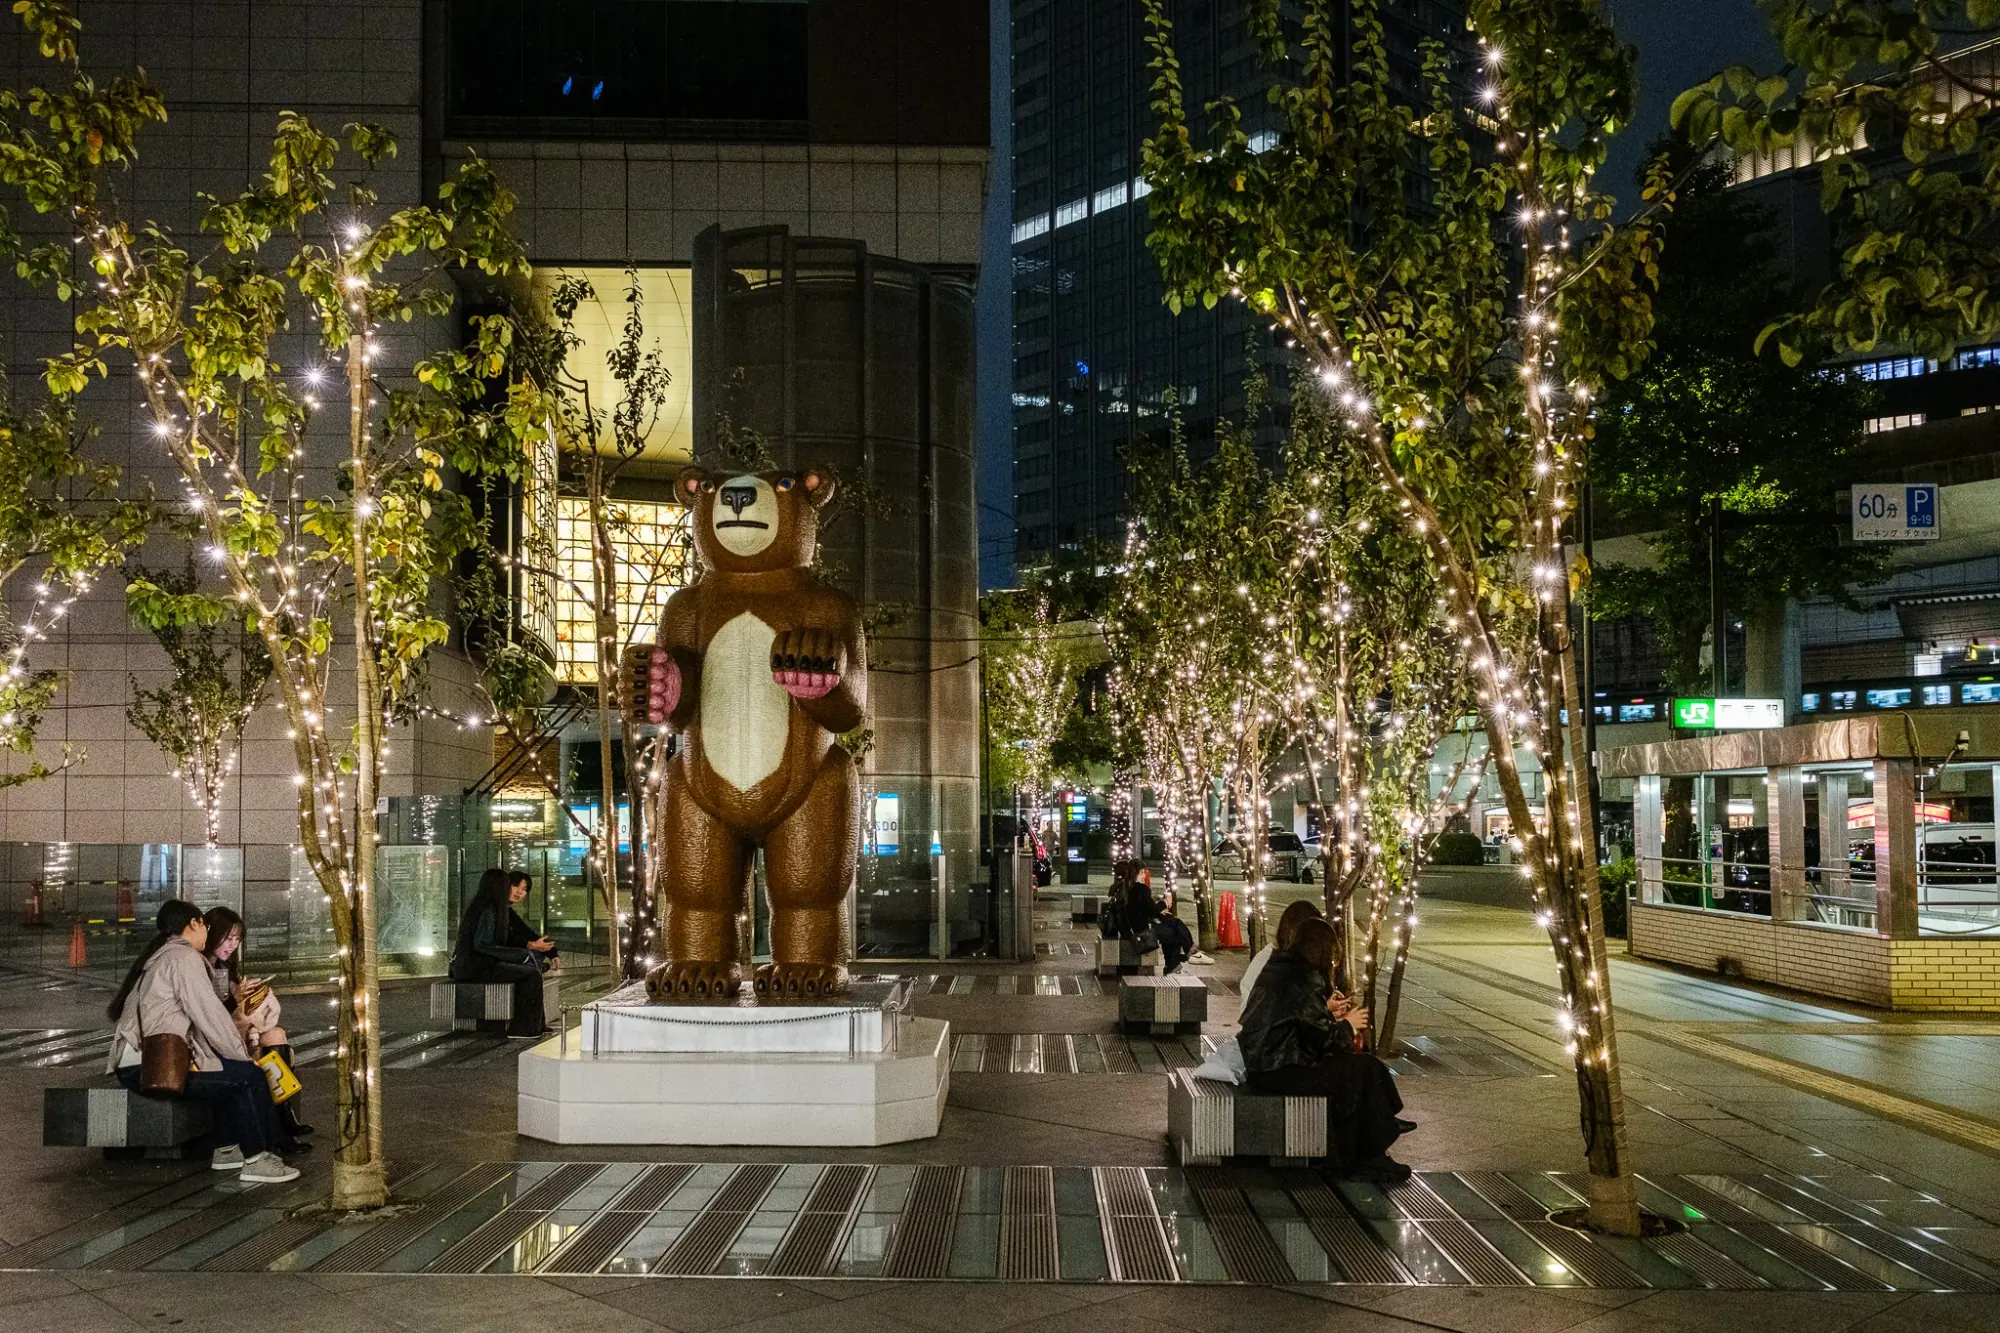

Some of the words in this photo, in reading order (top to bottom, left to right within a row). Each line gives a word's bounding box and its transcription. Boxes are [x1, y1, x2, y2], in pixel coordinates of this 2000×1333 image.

[1859, 493, 1898, 519] 60分
[1914, 489, 1929, 513] P
[1910, 514, 1932, 525] 9-19
[1680, 702, 1710, 720] JR
